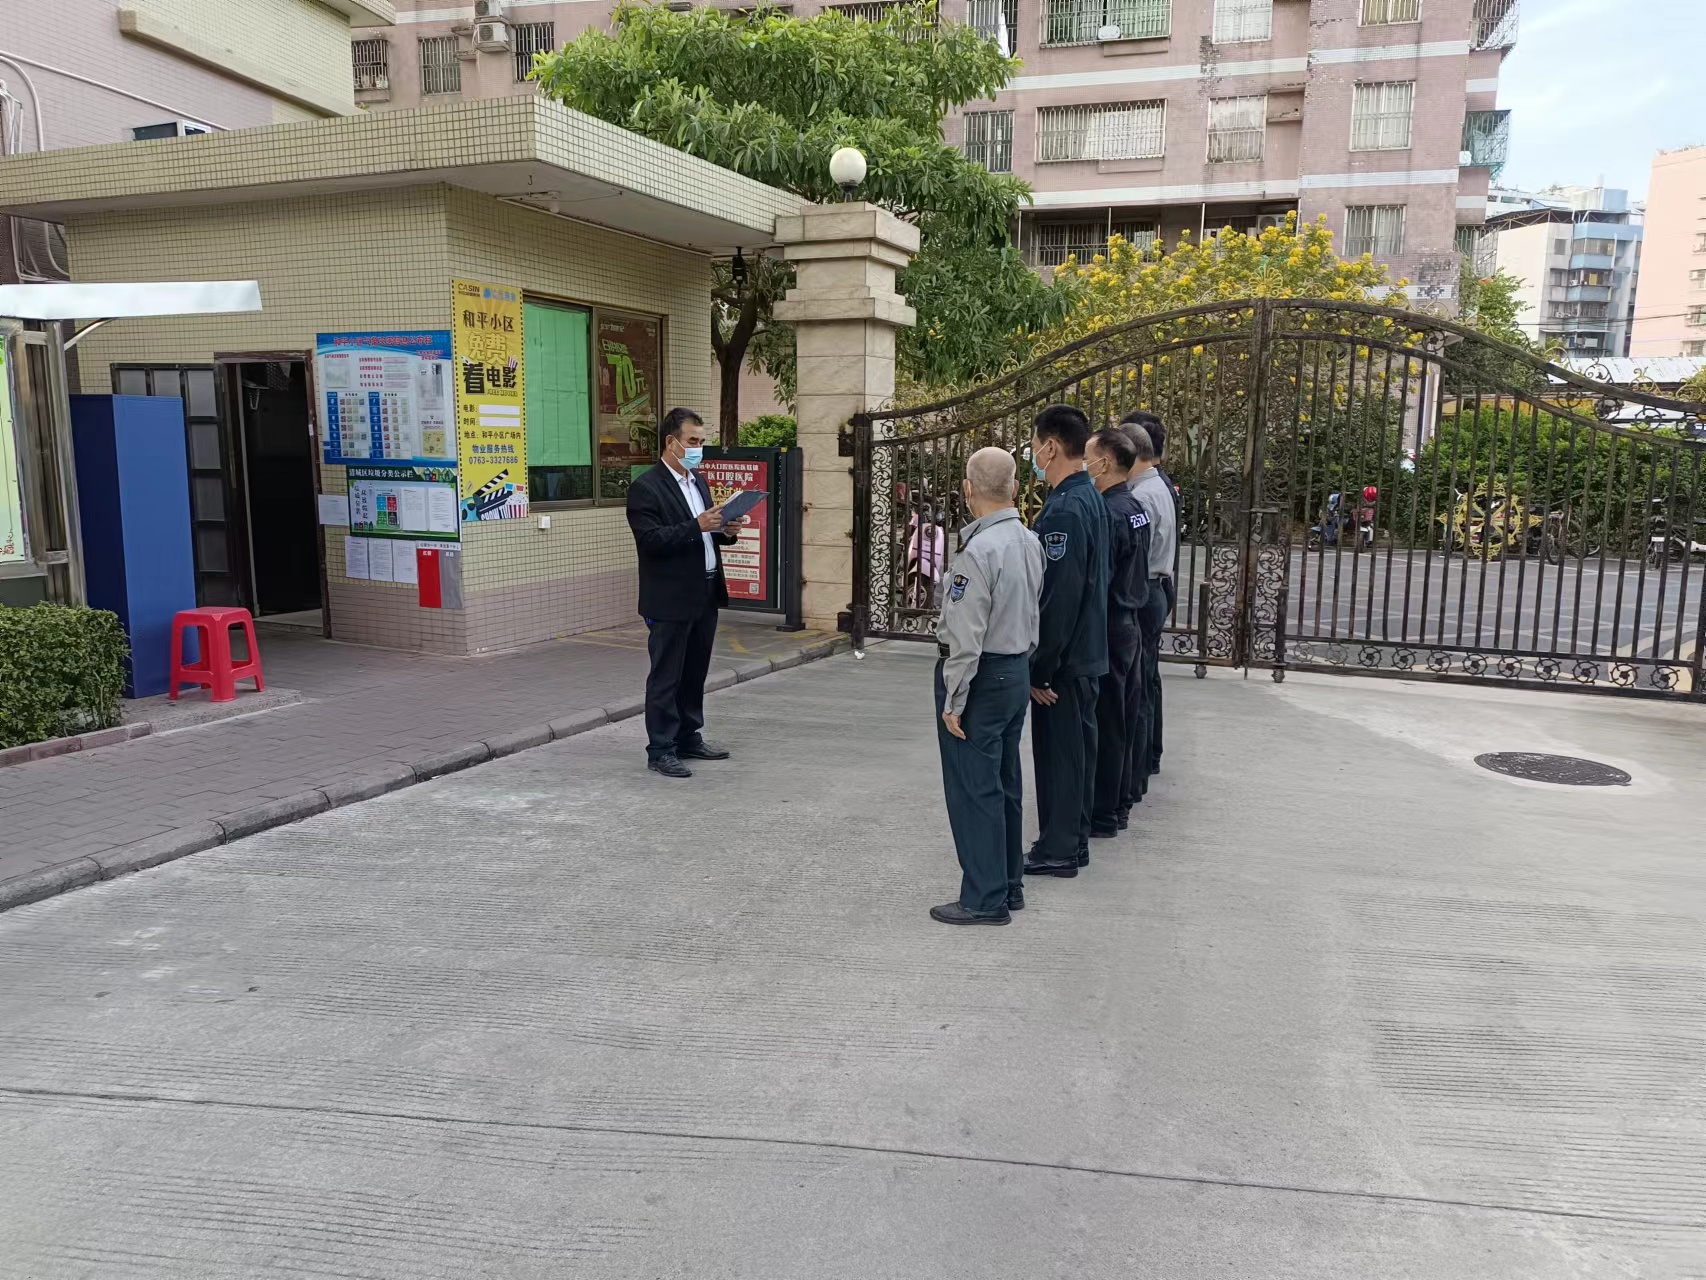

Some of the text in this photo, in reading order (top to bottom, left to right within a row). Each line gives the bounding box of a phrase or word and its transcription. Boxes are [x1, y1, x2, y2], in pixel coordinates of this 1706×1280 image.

[458, 283, 480, 292] CASIN
[463, 310, 515, 332] 和平小区
[468, 331, 507, 366] 免费
[463, 362, 517, 394] 看电影
[472, 444, 515, 454] 物业服务热线
[349, 468, 414, 478] 清城区垃圾分类公示栏
[699, 471, 753, 481] 医口腔医院
